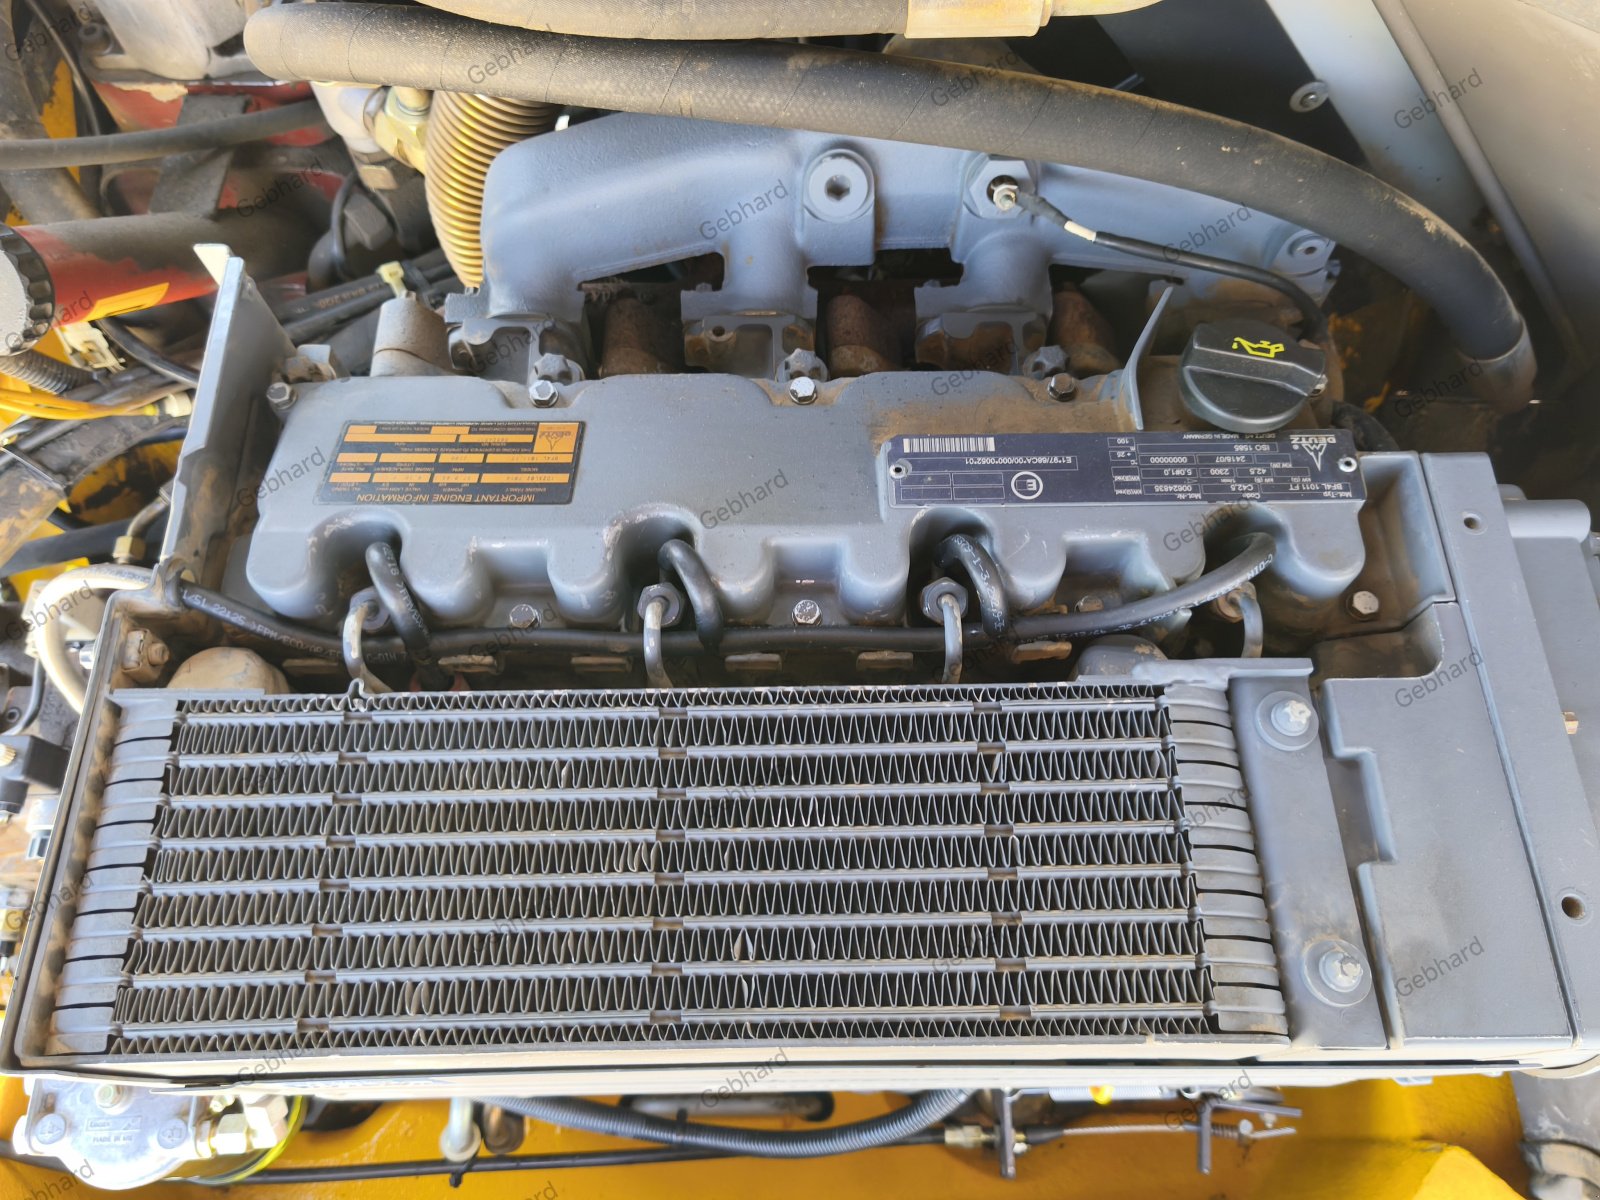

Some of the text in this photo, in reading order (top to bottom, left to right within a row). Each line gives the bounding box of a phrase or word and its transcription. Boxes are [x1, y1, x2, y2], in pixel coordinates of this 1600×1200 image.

[1027, 479, 1037, 490] E
[357, 493, 535, 502] IMPORTANT ENGINE INFORMATION
